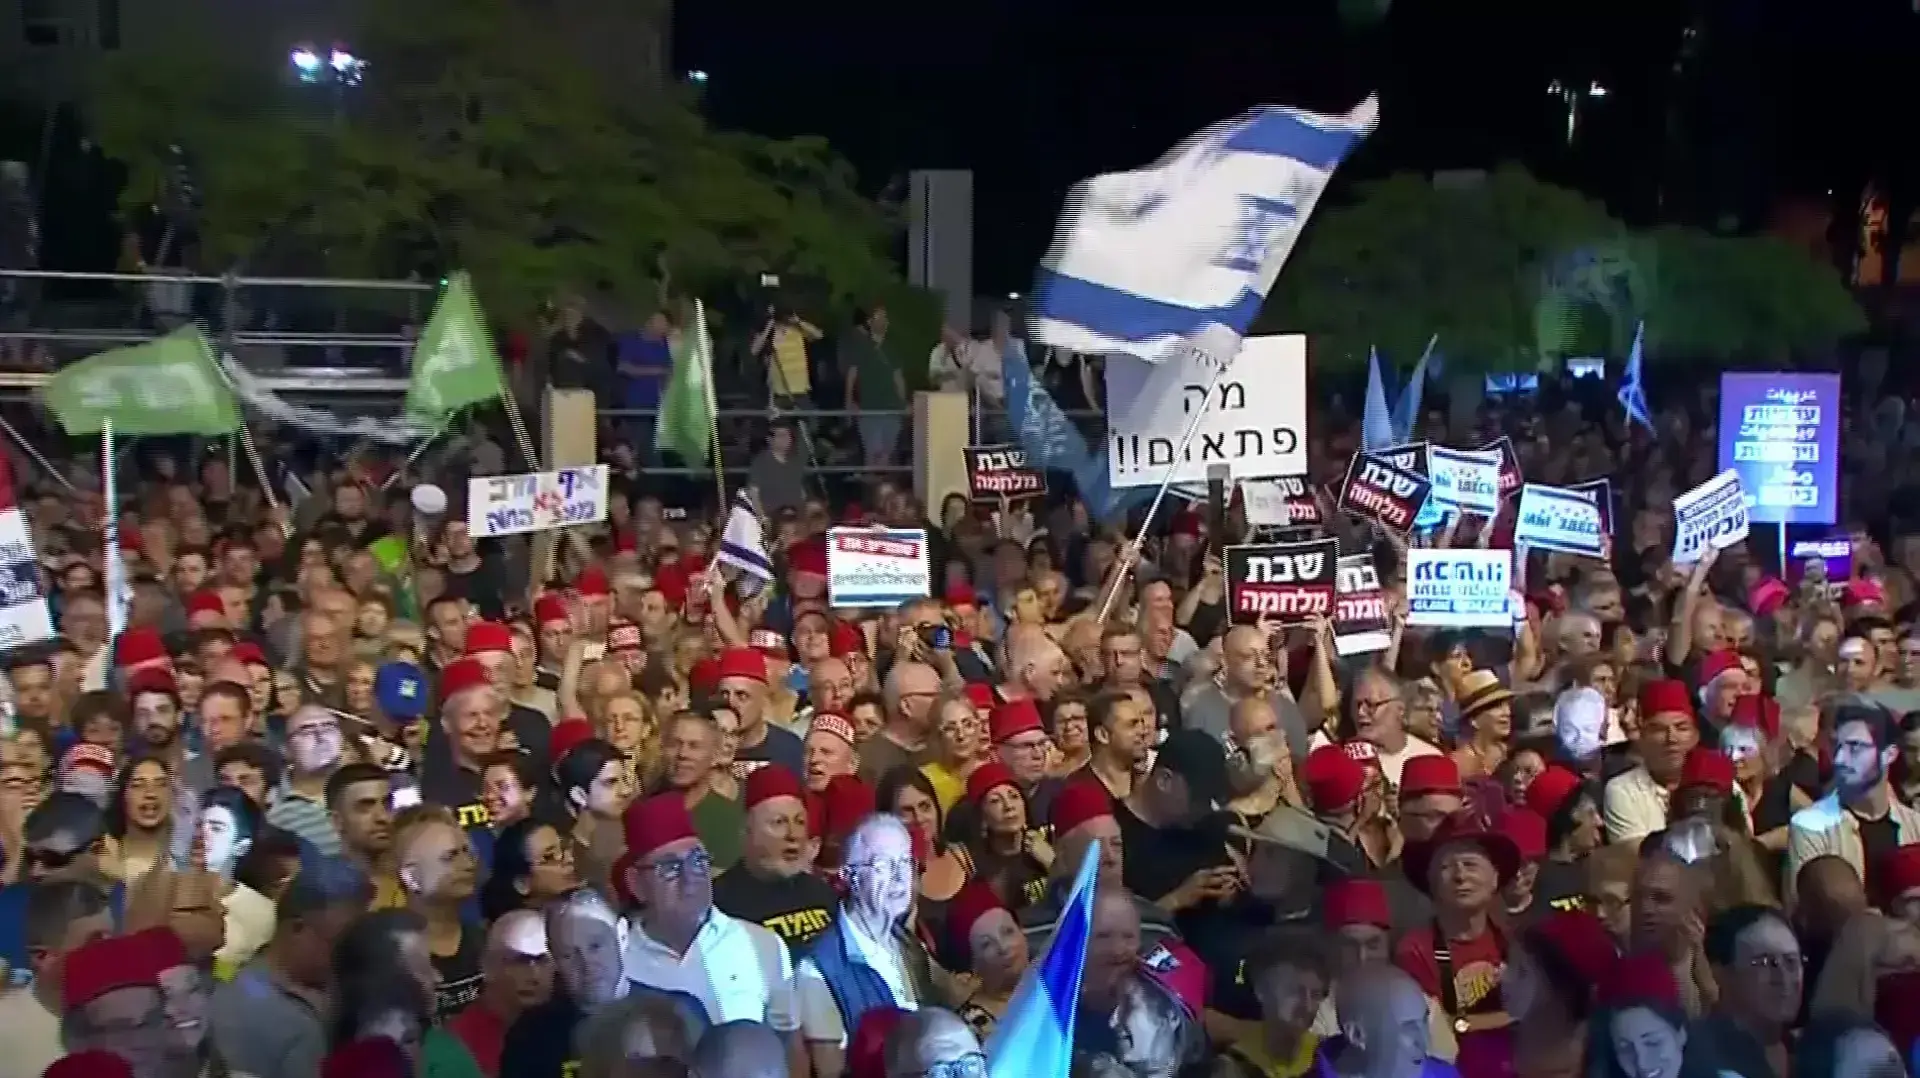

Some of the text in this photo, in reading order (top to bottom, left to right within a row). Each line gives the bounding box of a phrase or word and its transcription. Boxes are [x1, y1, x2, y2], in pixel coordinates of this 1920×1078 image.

[1183, 381, 1245, 414] מה
[976, 451, 1026, 471] שבת
[1117, 427, 1298, 473] פתאום!!
[976, 472, 1037, 490] מלחמה
[1360, 463, 1421, 498] שבת
[1349, 483, 1407, 524] מלחמה
[1245, 552, 1325, 583] שבת
[1241, 588, 1328, 612] מלחמה
